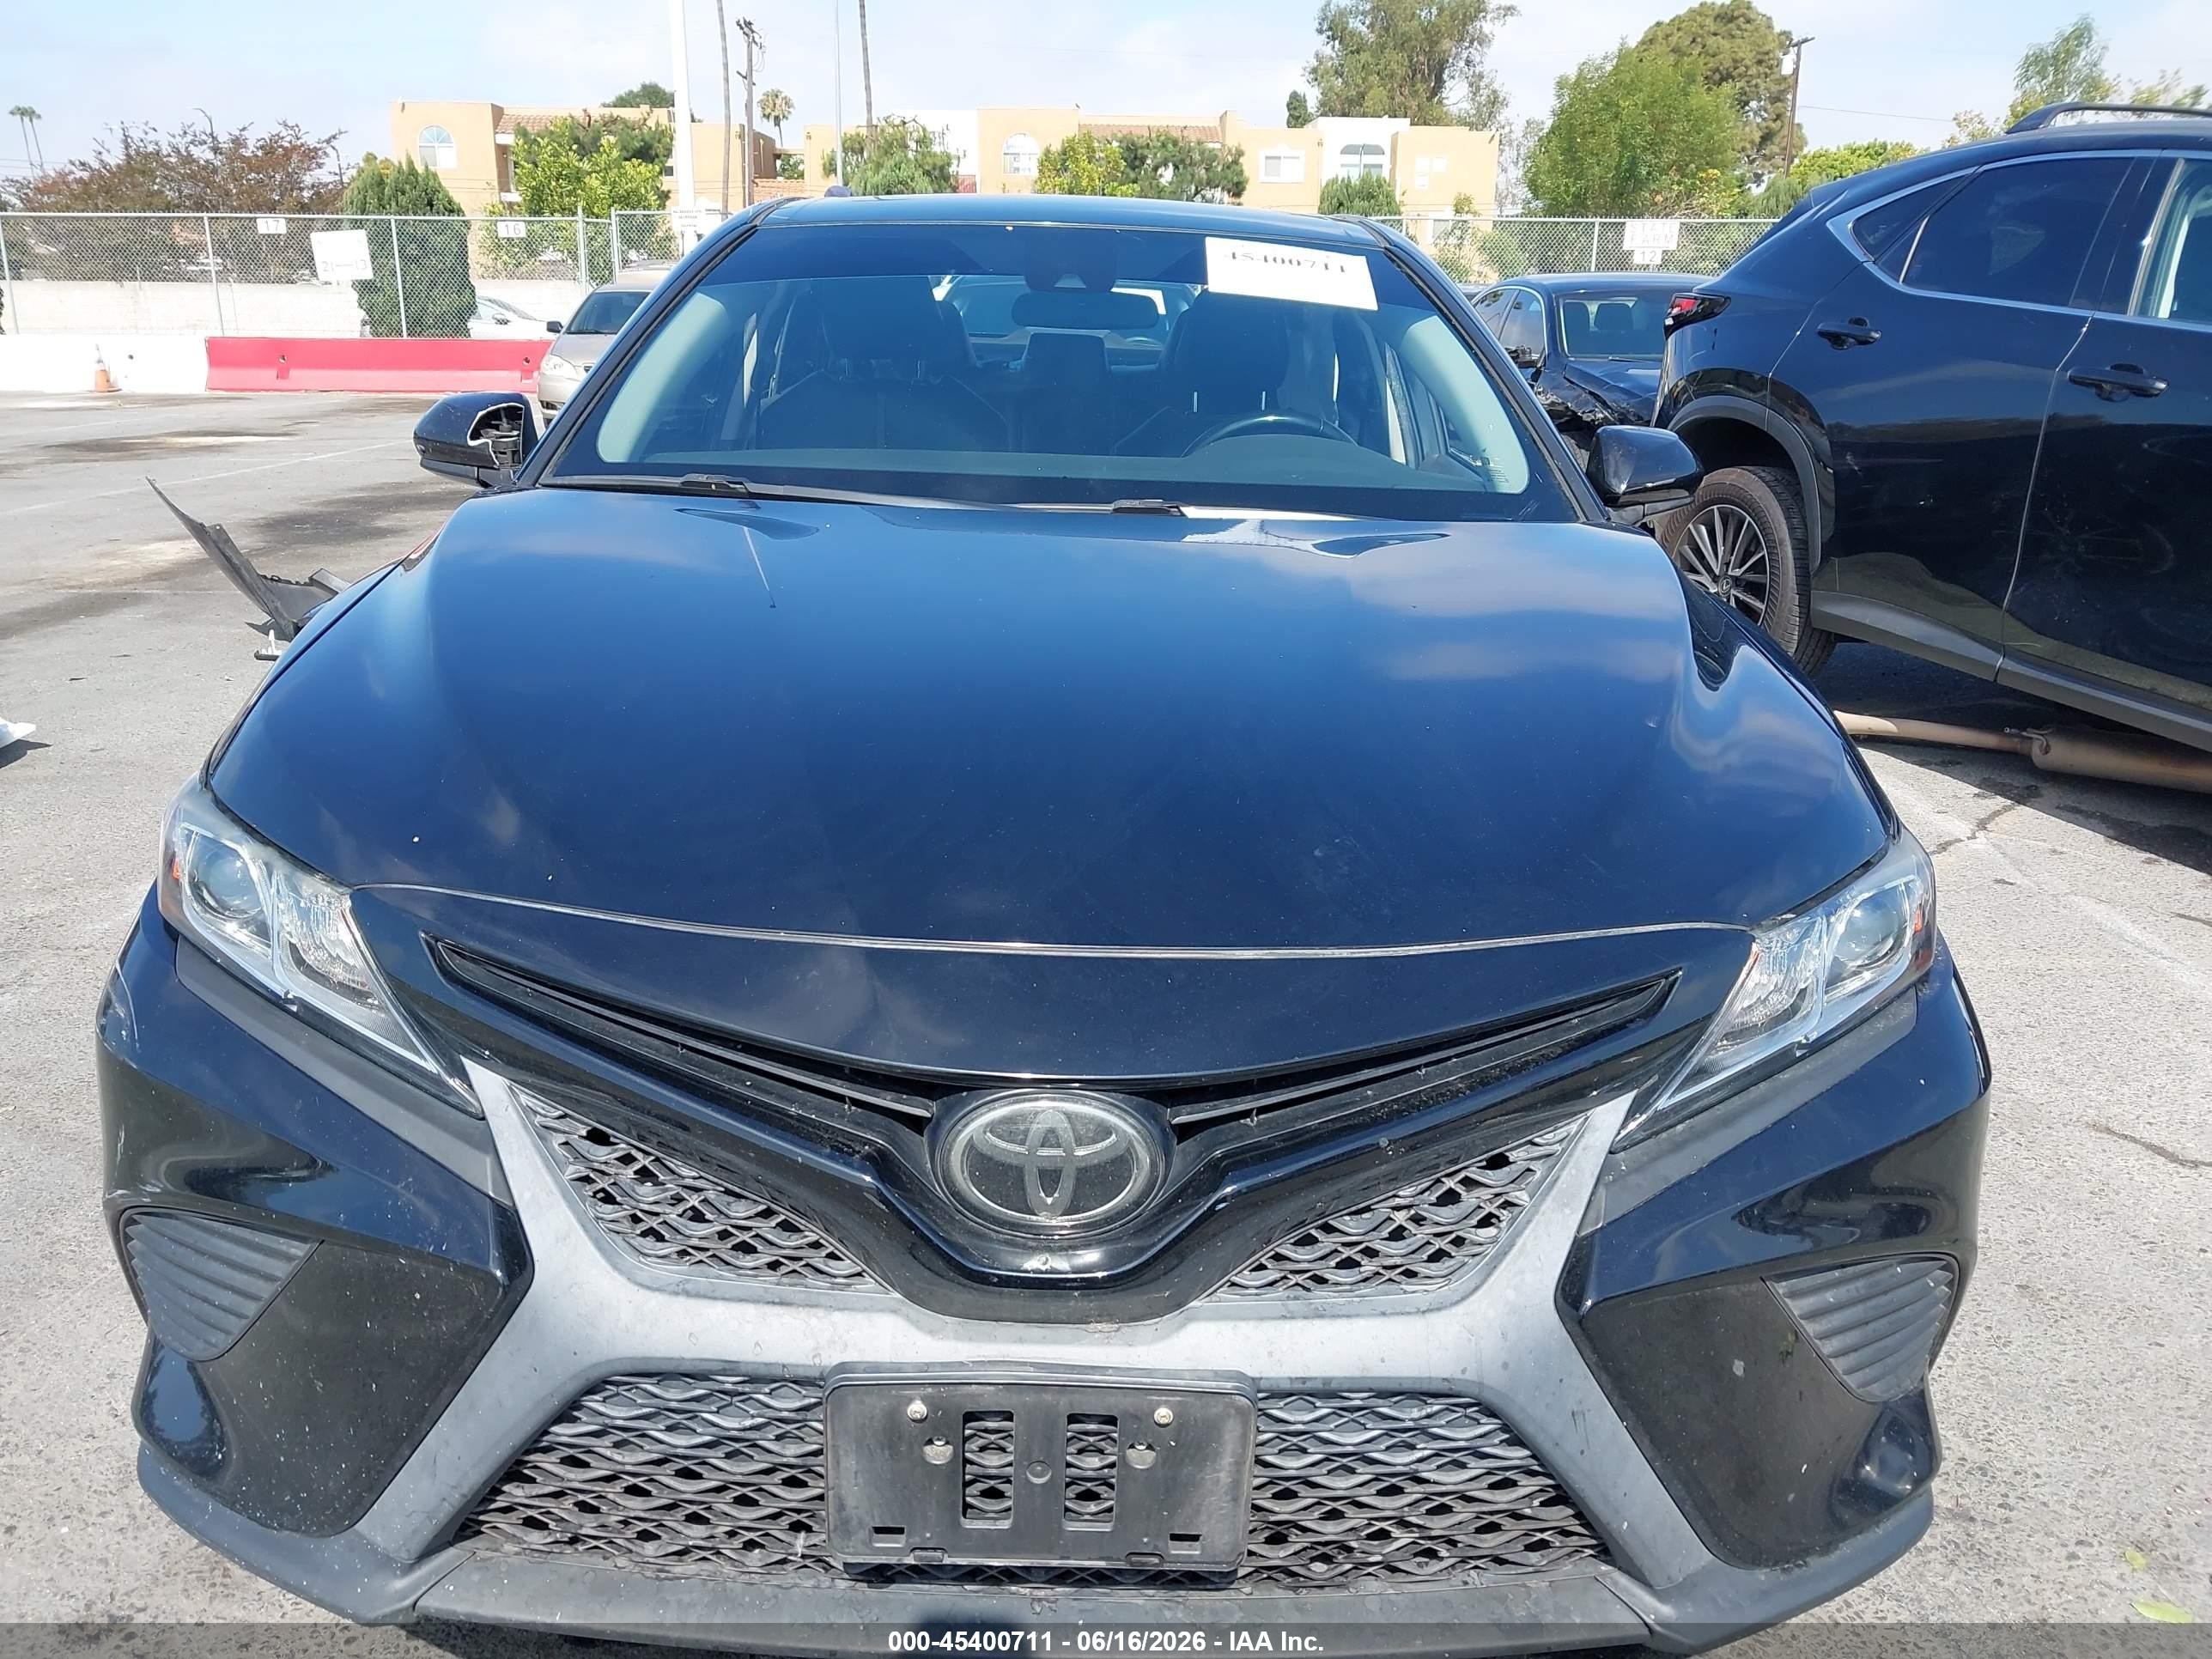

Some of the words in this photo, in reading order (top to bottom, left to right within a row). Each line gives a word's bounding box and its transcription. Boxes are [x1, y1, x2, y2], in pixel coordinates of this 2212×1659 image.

[265, 220, 280, 232] 17
[505, 223, 521, 235] 16
[1640, 250, 1656, 263] 12
